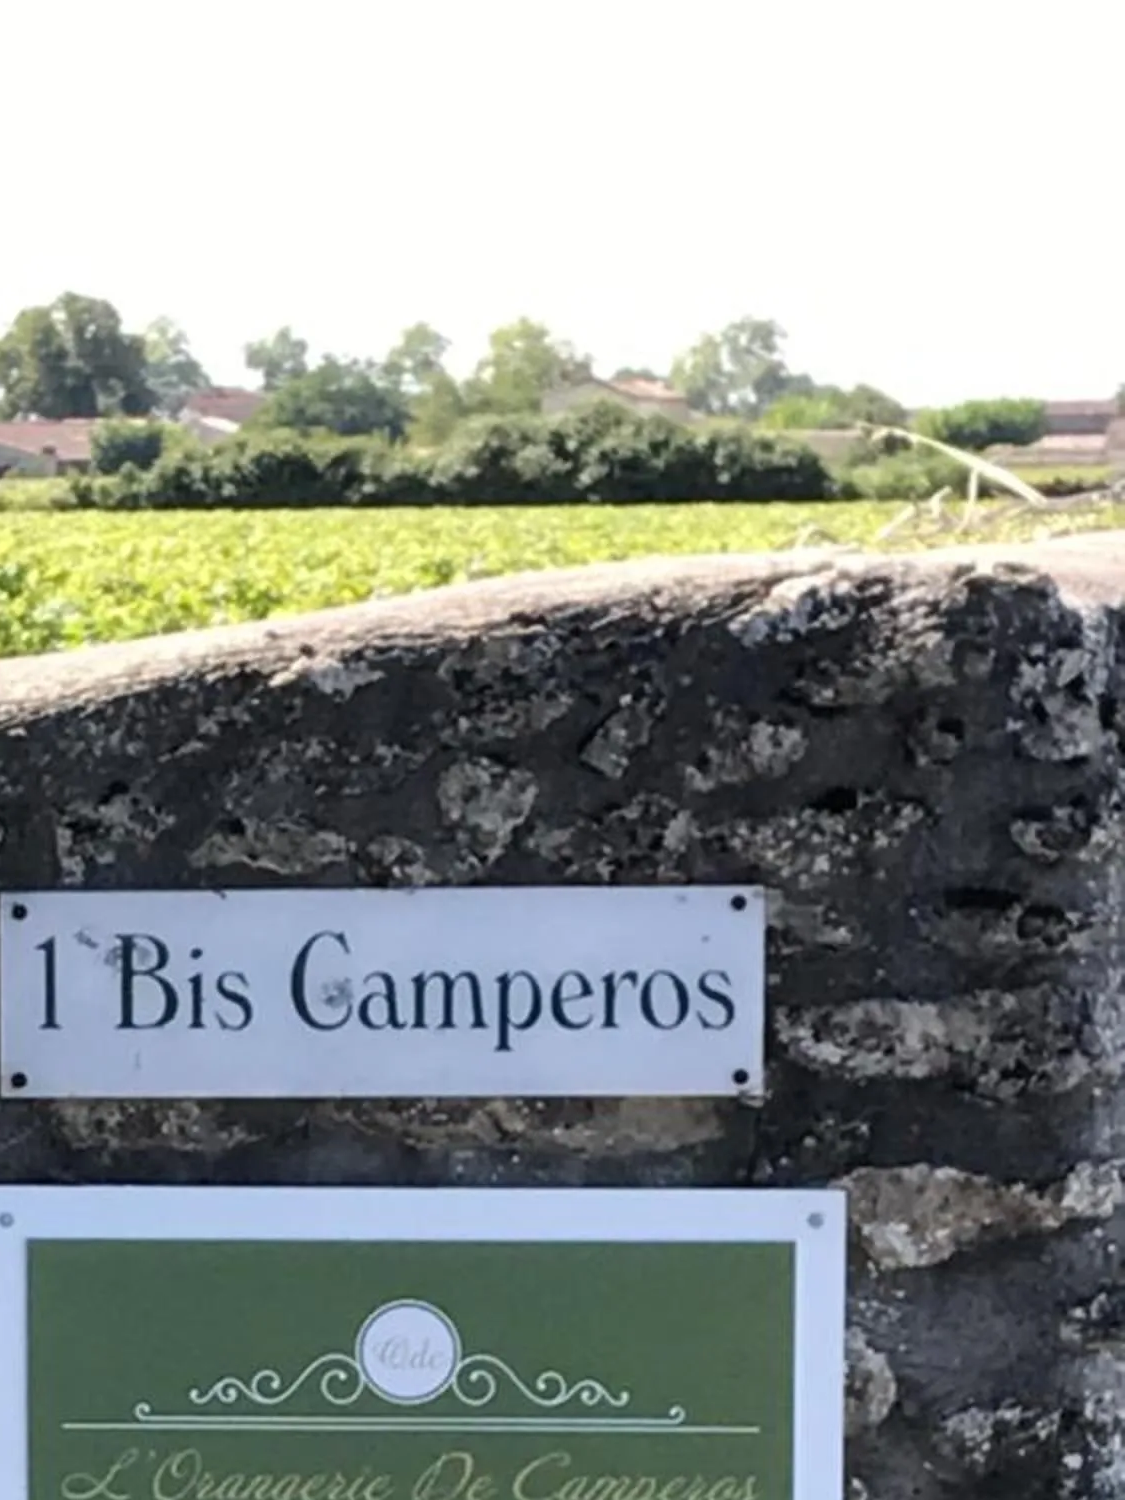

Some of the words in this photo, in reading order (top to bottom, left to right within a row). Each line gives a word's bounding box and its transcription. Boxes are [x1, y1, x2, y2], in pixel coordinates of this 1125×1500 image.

[34, 935, 63, 1030] 1
[114, 931, 255, 1032] Bis
[289, 930, 736, 1052] Camperos
